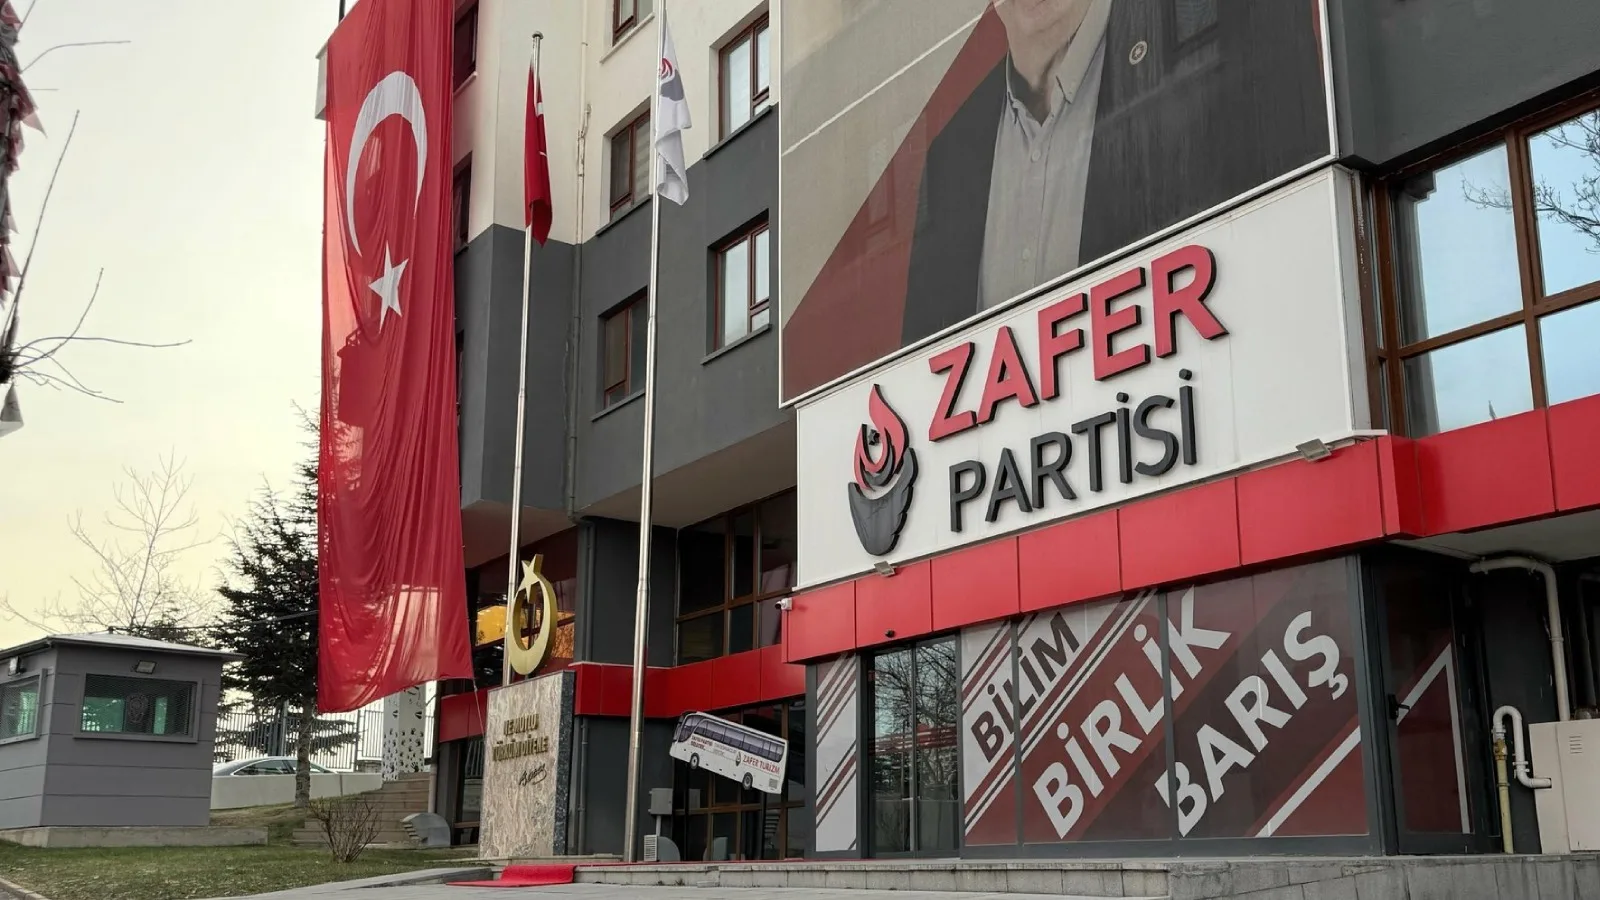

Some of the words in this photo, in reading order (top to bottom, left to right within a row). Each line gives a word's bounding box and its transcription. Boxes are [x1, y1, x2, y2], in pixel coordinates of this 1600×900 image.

[928, 244, 1230, 443] ZAFER
[949, 368, 1197, 533] PARTİSİ
[743, 754, 759, 767] ZAFER
[971, 611, 1080, 763] BİLİM
[1032, 585, 1231, 839] BİRLİK
[1155, 610, 1348, 838] BARIŞ
